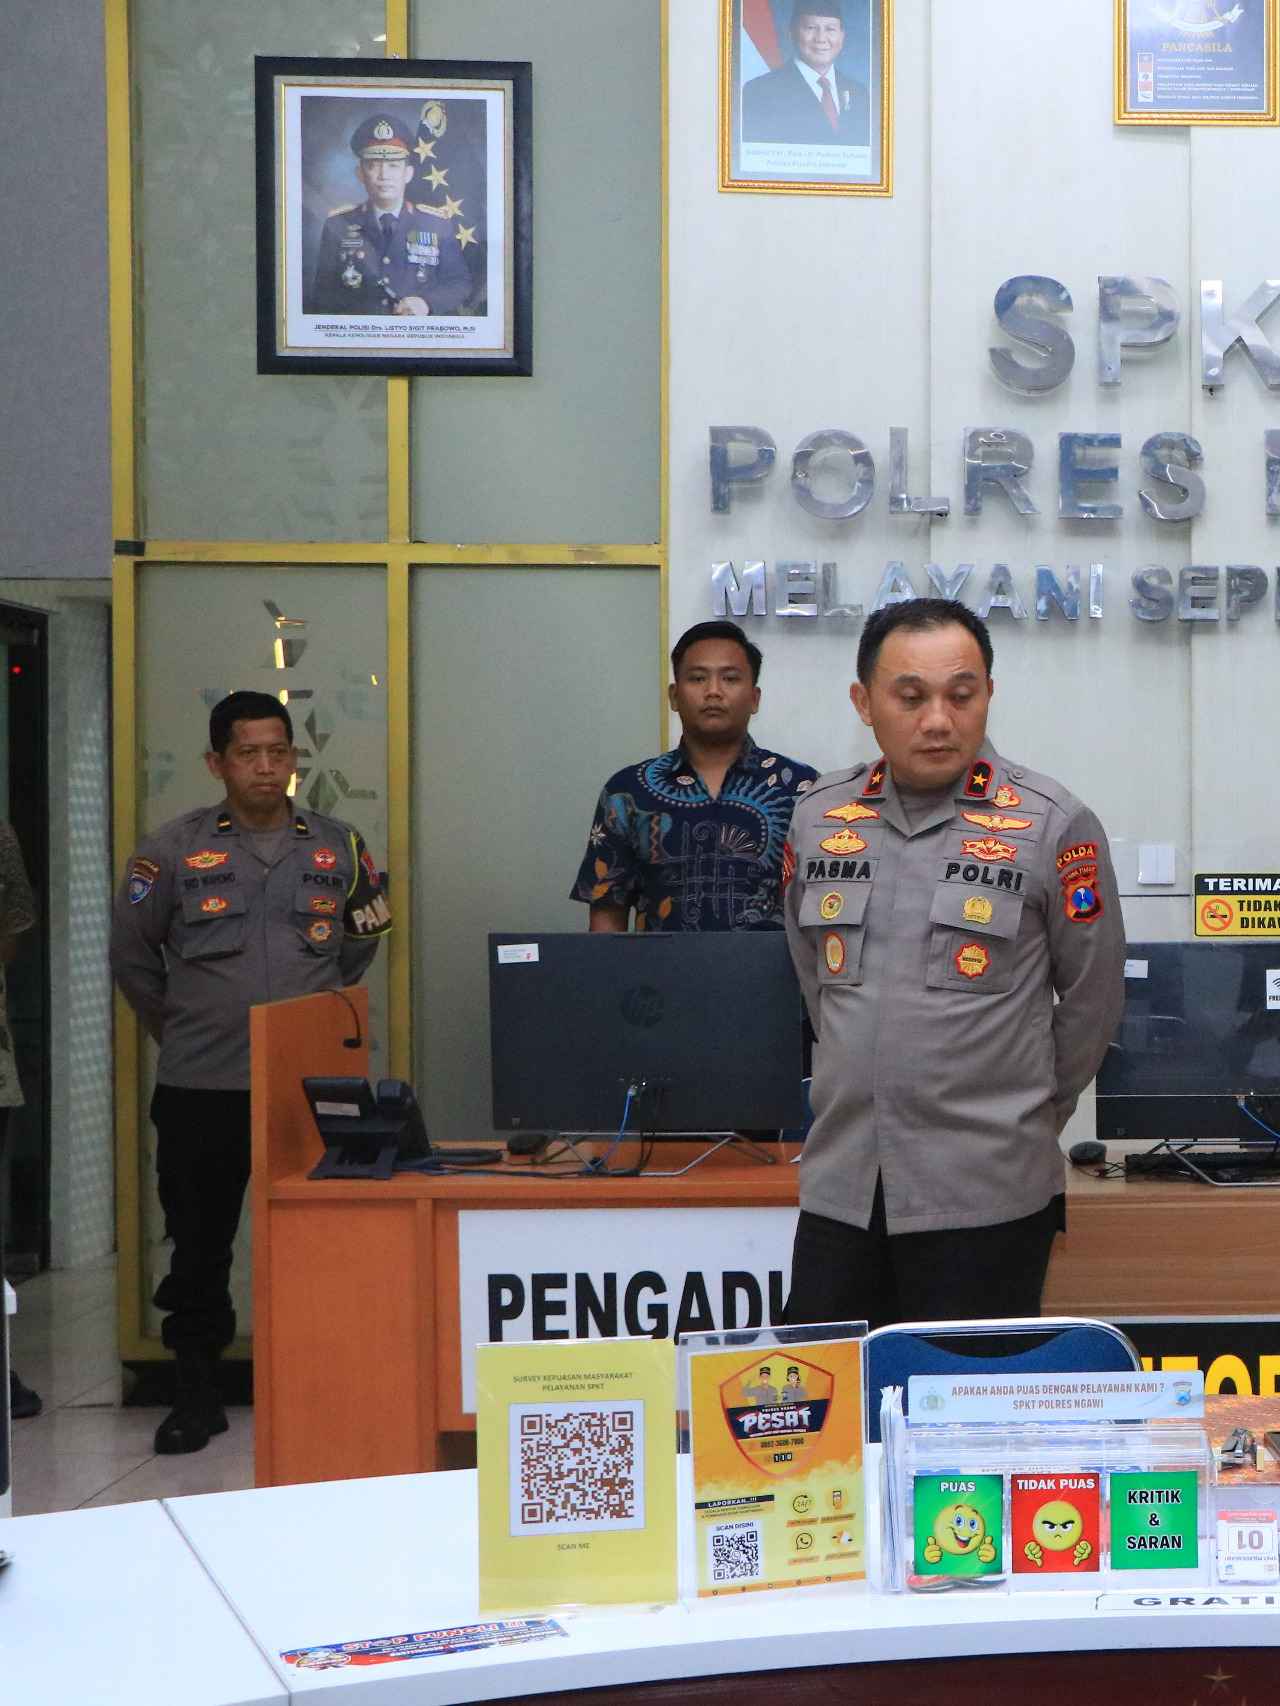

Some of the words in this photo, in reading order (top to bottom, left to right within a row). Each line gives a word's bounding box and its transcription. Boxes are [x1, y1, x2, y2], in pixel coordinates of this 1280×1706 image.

[708, 425, 1206, 521] POLRES
[711, 560, 1103, 621] MELAYANI
[1056, 845, 1094, 868] POLDA
[806, 860, 871, 880] PASMA
[945, 862, 1023, 891] POLRI
[513, 1374, 541, 1383] SURVEY
[543, 1373, 582, 1382] KEPUASAN
[584, 1372, 633, 1381] MASYARAKAT
[542, 1383, 585, 1392] PELAYANAN
[951, 1385, 988, 1396] APAKAH
[989, 1385, 1015, 1396] ANDA
[1016, 1384, 1040, 1395] PUAS
[1042, 1383, 1079, 1394] DENGAN
[1080, 1383, 1132, 1394] PELAYANAN
[1135, 1382, 1158, 1393] KAMI
[1159, 1382, 1165, 1393] ?
[1013, 1399, 1036, 1410] SPKT
[1038, 1399, 1072, 1410] POLRES
[1073, 1398, 1104, 1409] NGAWI
[738, 1406, 812, 1434] PESAT
[940, 1482, 976, 1493] PUAS
[1017, 1479, 1056, 1490] TIDAK
[1058, 1478, 1095, 1490] PUAS
[1128, 1489, 1181, 1504] KRITIK
[1149, 1513, 1160, 1526] &
[557, 1543, 577, 1551] SCAN
[1127, 1535, 1182, 1549] SARAN
